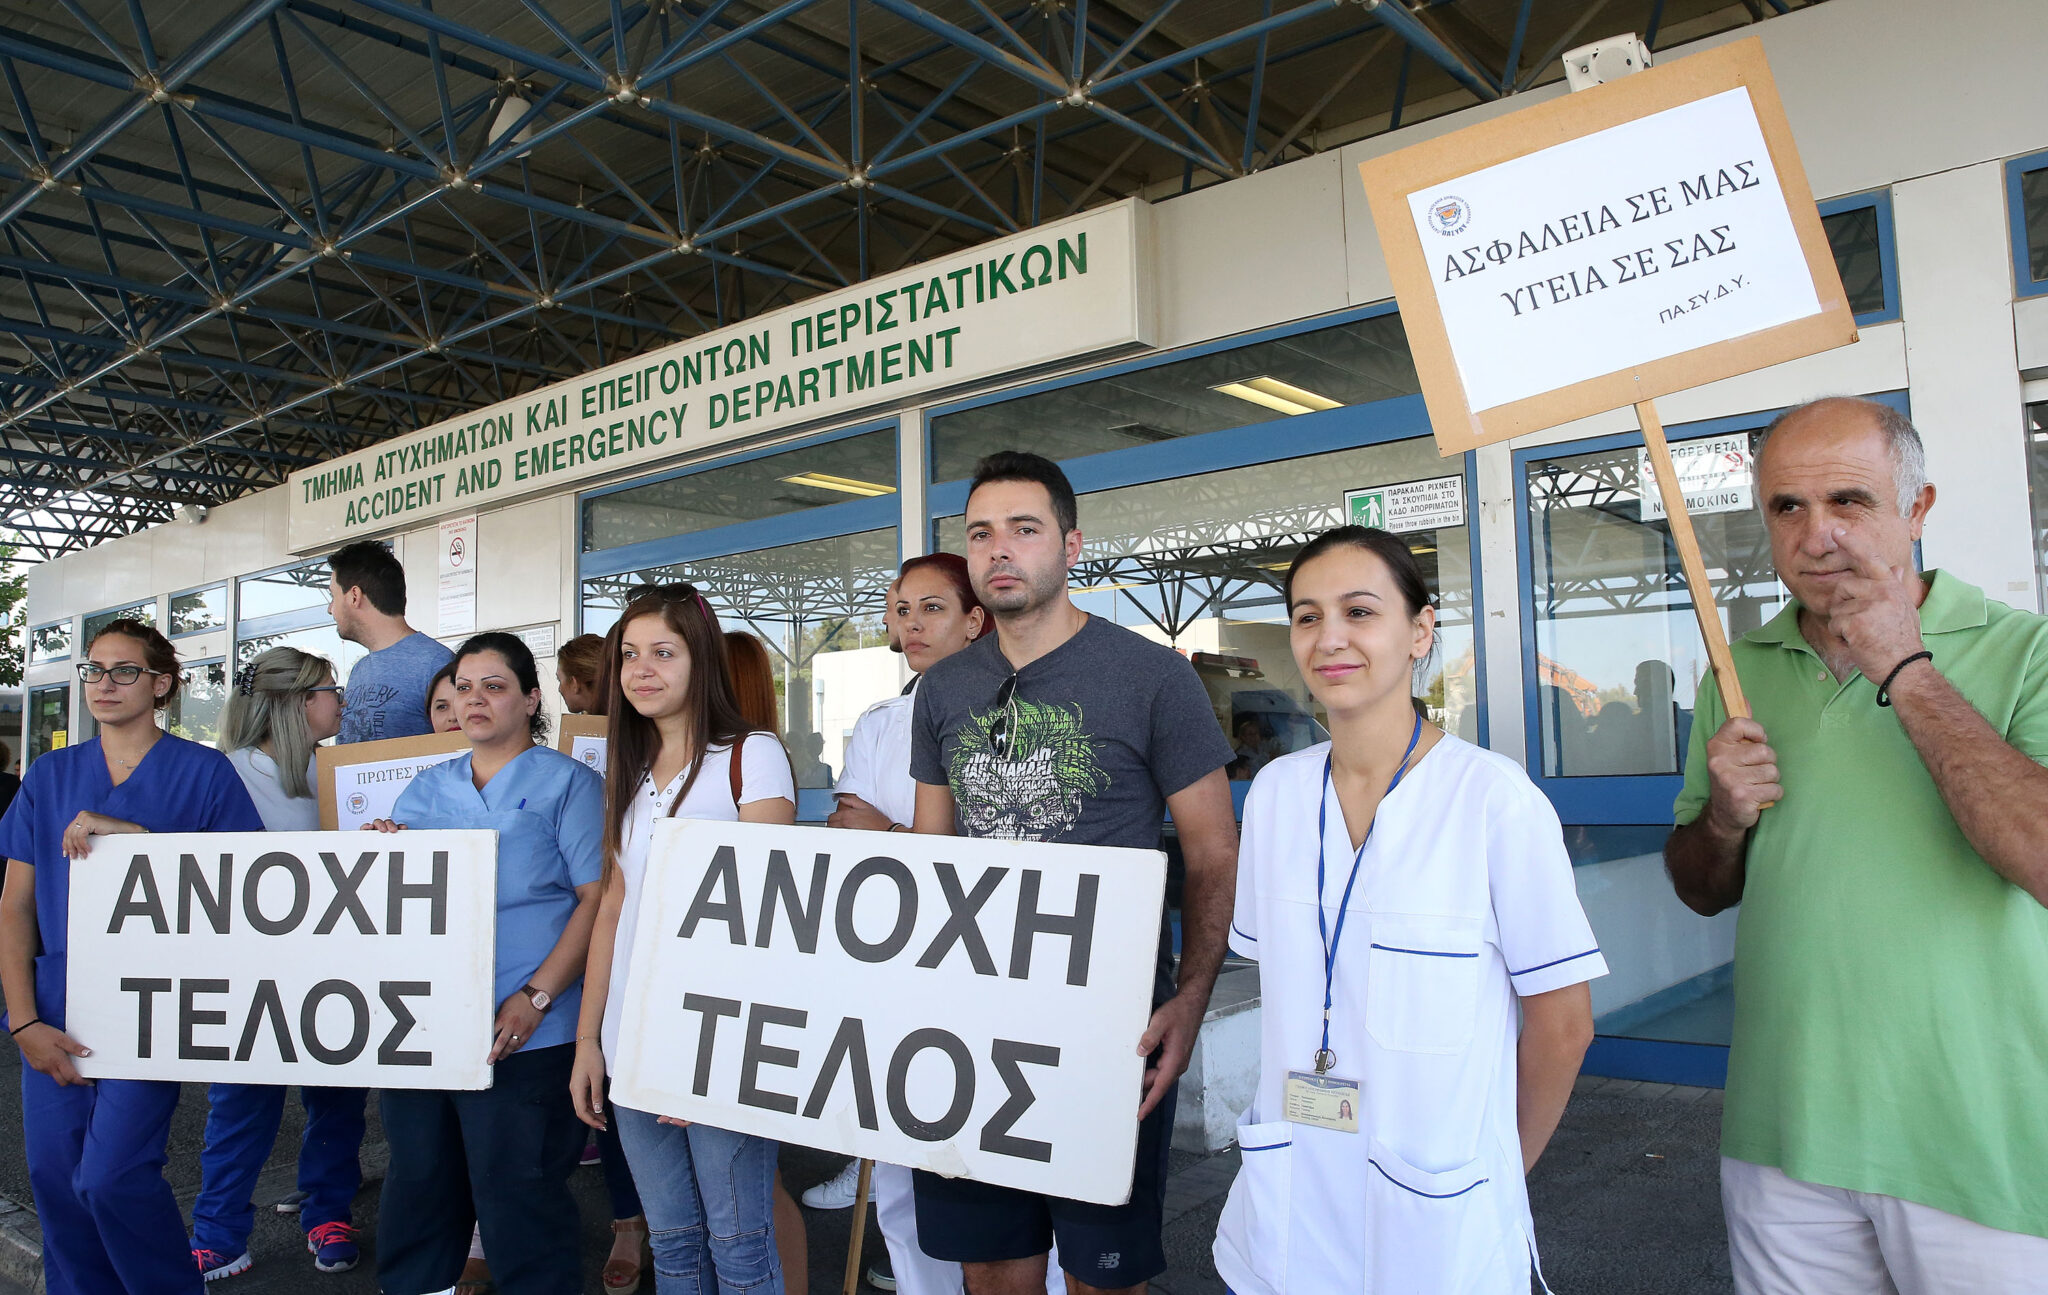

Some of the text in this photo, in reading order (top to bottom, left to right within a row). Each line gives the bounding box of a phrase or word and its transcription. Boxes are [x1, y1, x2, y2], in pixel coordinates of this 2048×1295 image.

[1444, 205, 1622, 282] ΑΣΦΑΛΕΙΑ
[1625, 187, 1673, 223] ΣΕ
[1678, 160, 1760, 207] ΜΑΣ
[1501, 225, 1736, 316] ΥΓΕΙΑ ΣΕ ΣΑΣ
[1659, 274, 1750, 323] ΠΑ.ΣΥ.Δ.Υ.
[303, 232, 1087, 504] ΤΜΗΜΑ ΑΤΥΧΗΜΑΤΩΝ ΚΑΙ ΕΠΕΙΓΟΝΤΩΝ ΠΕΡΙΣΤΑΤΙΚΩΝ
[345, 326, 961, 527] ACCIDENT AND EMERGENCY DEPARTMENT
[1388, 480, 1457, 497] ΠΑΡΑΚΑΛΩ ΡΙΧΝΕΤΕ
[1388, 500, 1459, 517] ΚΑΔΟ ΑΠΟΡΡΙΜΑΤΩΝ
[1389, 514, 1460, 530] Please throw rubbish in the bin
[1391, 490, 1455, 506] ΤΑ ΣΚΟΥΠΙΔΙΑ ΣΤΟ
[1686, 493, 1739, 509] MOKING
[357, 767, 413, 785] ΠΡΩΤΕΣ
[107, 851, 449, 936] ΑΝΟΧΗ
[678, 846, 1099, 987] ΑΝΟΧΗ
[121, 978, 432, 1066] ΤΕΛΟΣ
[683, 993, 1060, 1163] ΤΕΛΟΣ
